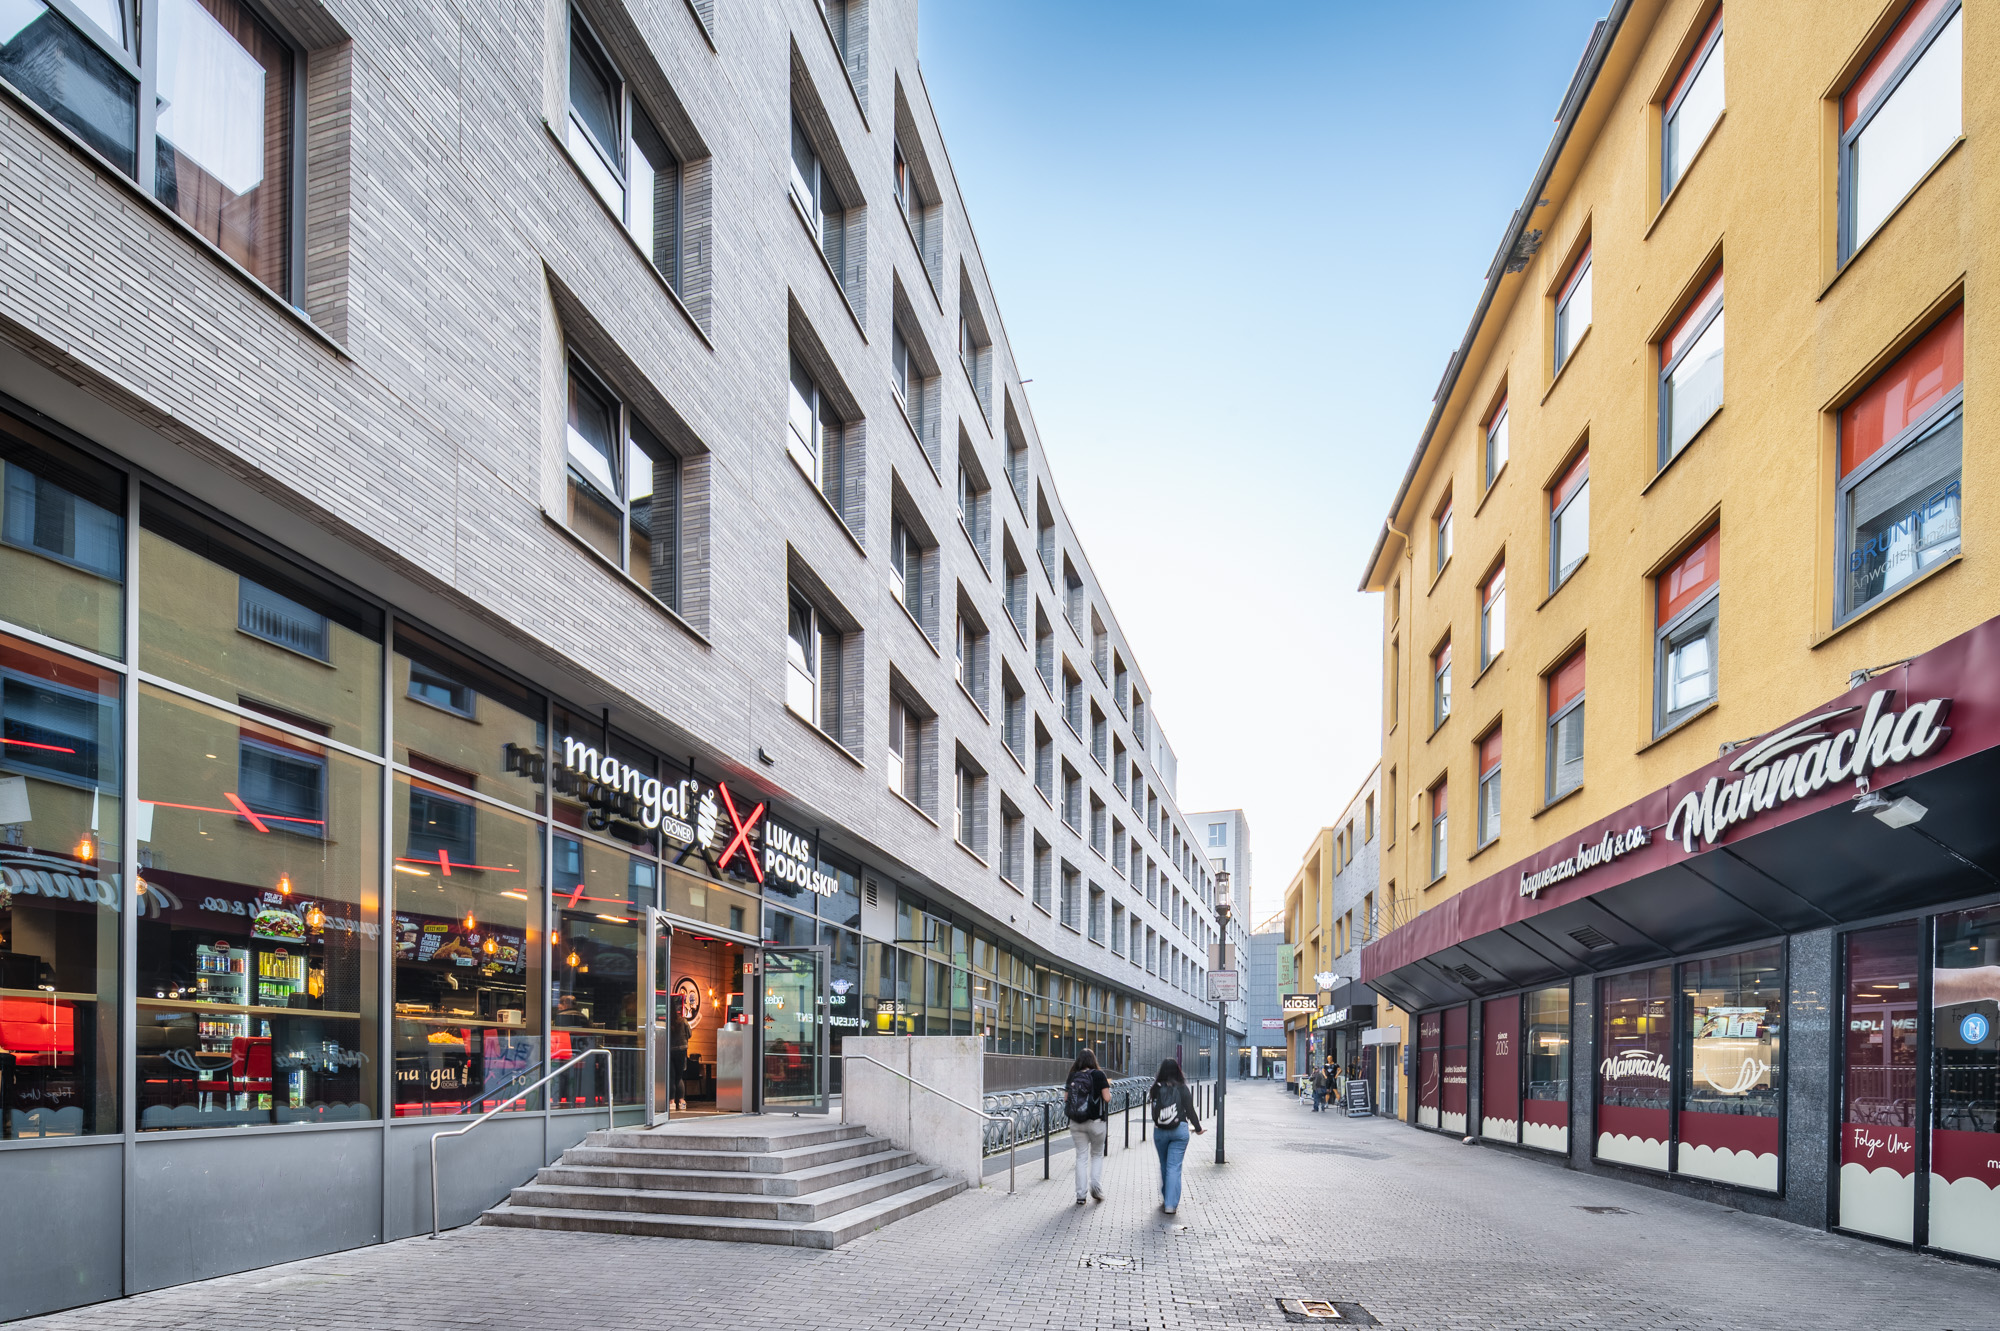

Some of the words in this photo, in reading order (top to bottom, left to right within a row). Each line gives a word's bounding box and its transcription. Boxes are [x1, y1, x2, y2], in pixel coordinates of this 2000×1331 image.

[1850, 480, 1961, 574] BRUNNER
[1853, 514, 1961, 590] Anwaltskanzle
[1666, 689, 1951, 853] Mannacha
[664, 818, 693, 841] DÖNER
[766, 821, 809, 862] LUKAS
[1577, 831, 1614, 870] bowls
[1615, 835, 1625, 856] &
[1626, 825, 1648, 850] co.
[1284, 1000, 1316, 1008] KIOSK
[1496, 1040, 1509, 1056] 2005
[1497, 1032, 1508, 1040] since
[1600, 1053, 1671, 1082] Mannacha
[1160, 1102, 1177, 1121] NIKE
[1854, 1128, 1885, 1158] Folge
[1887, 1132, 1912, 1154] Uns
